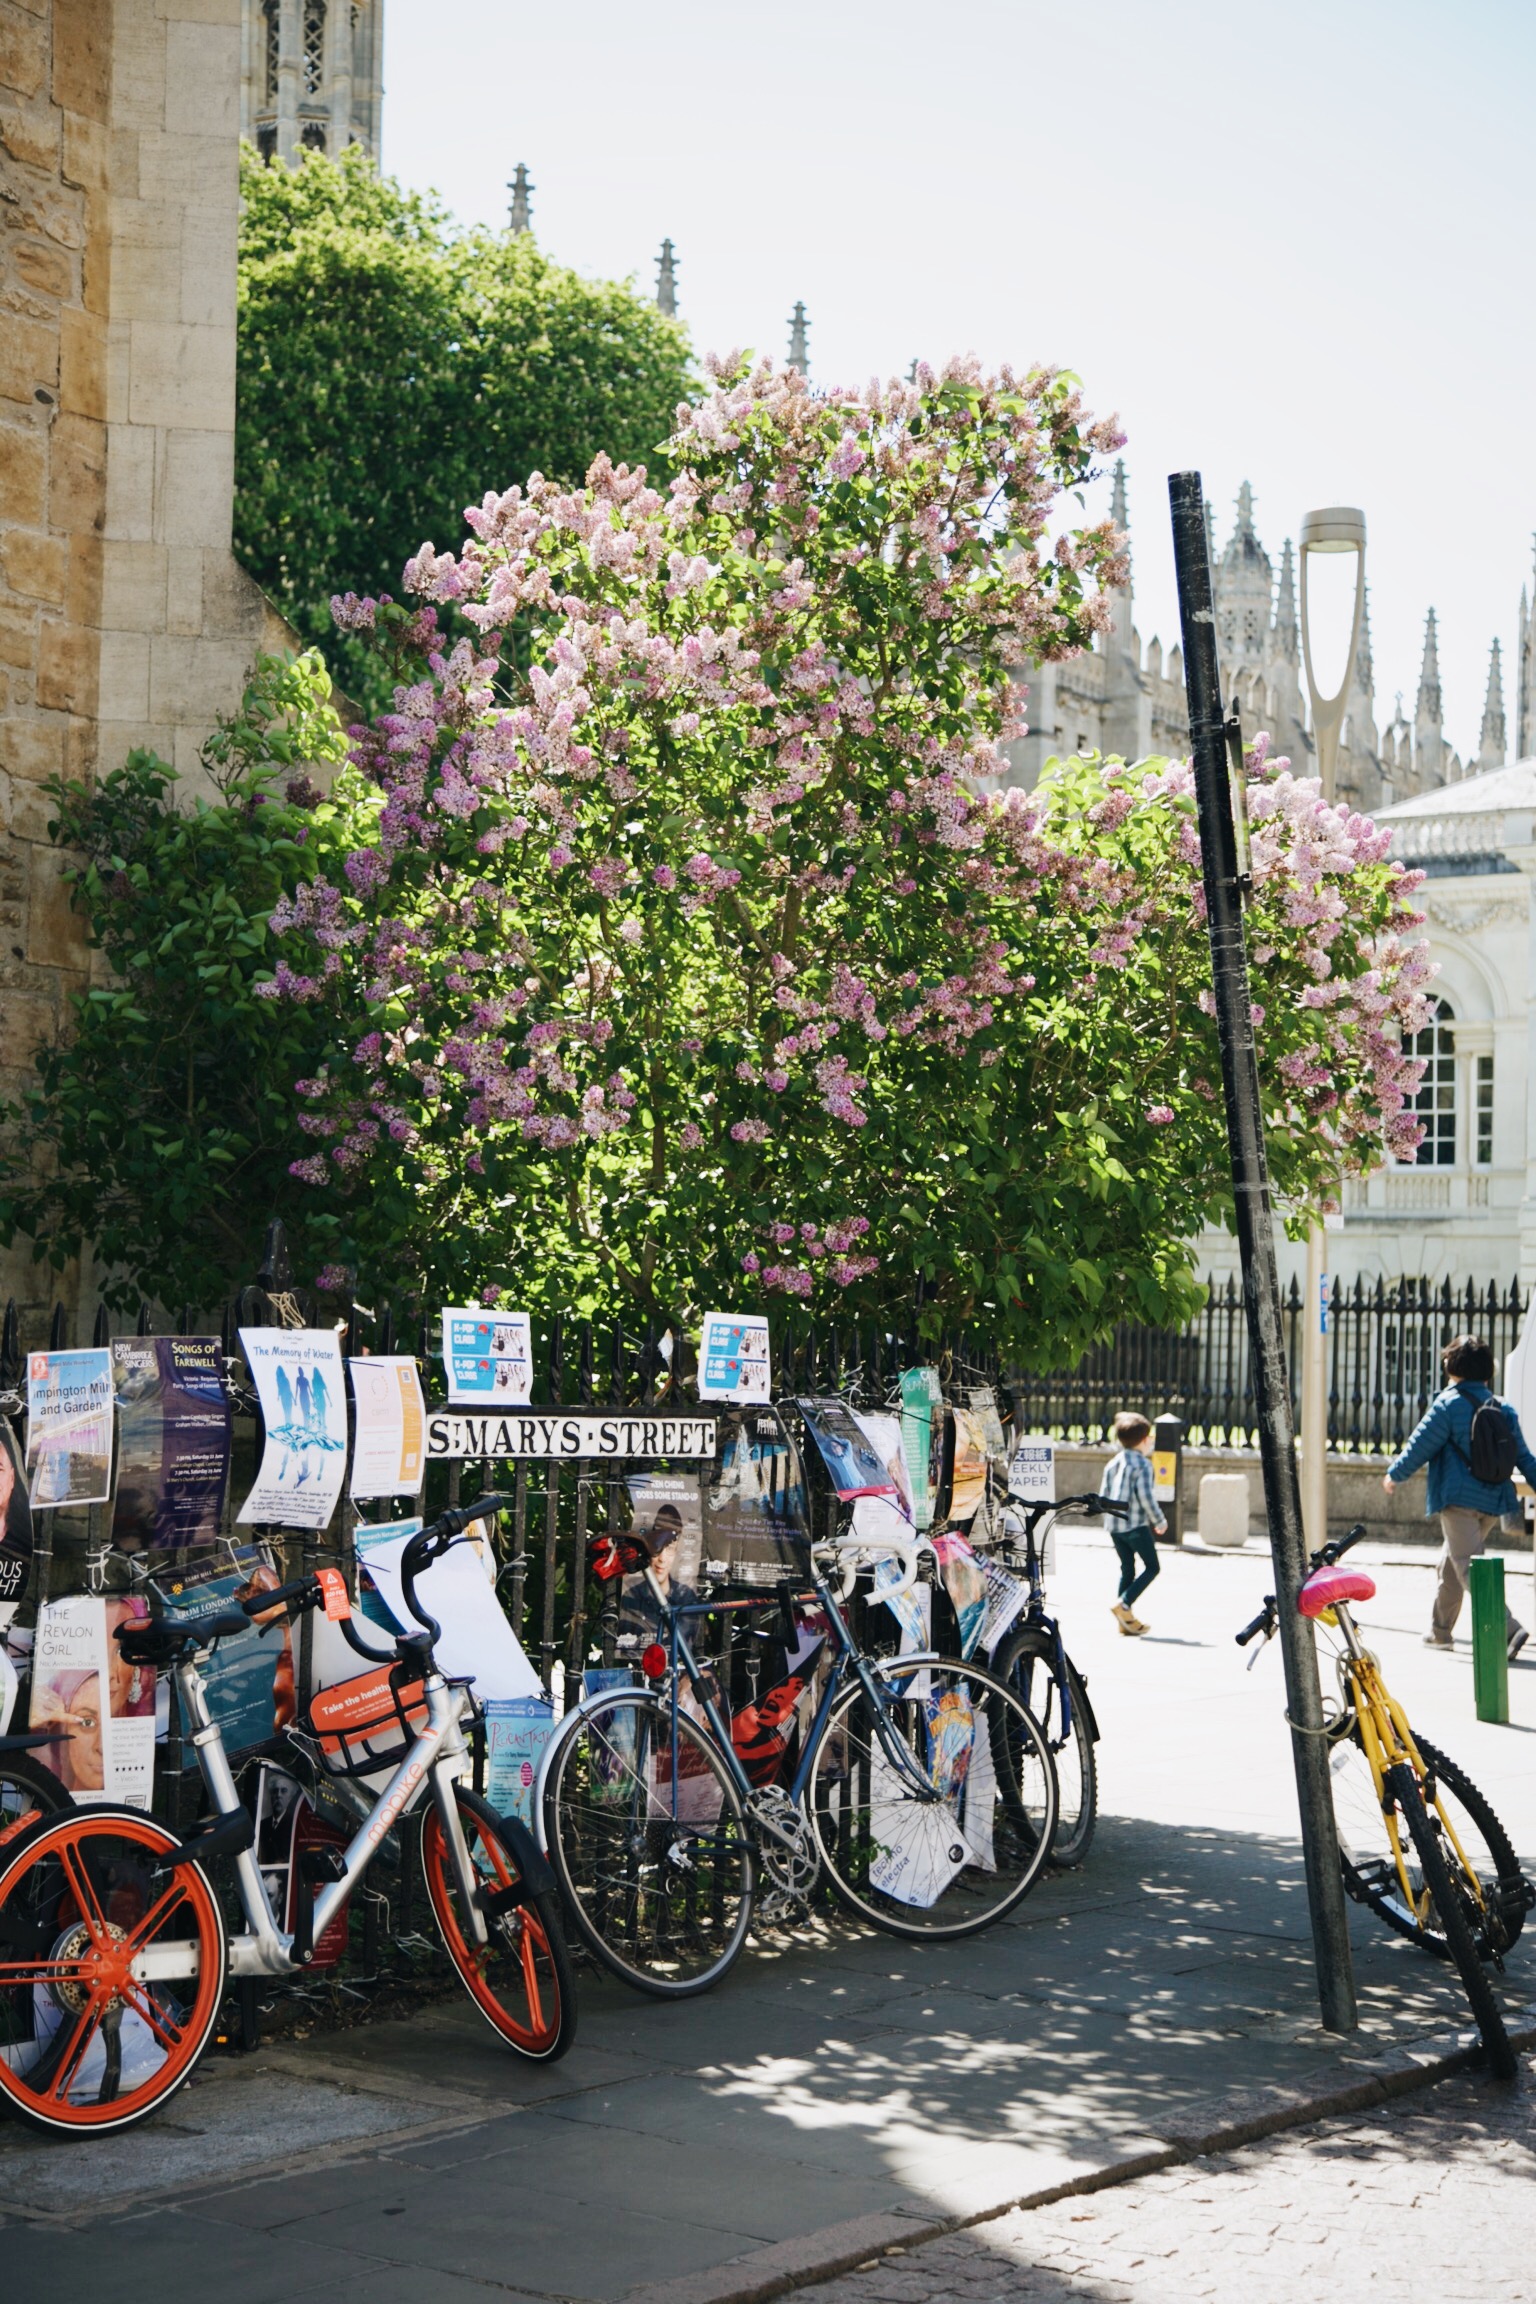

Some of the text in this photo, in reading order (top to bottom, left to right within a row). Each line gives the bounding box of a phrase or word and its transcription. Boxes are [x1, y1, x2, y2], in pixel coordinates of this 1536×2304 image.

[454, 1323, 475, 1333] K-POP
[454, 1334, 476, 1344] CLASS
[114, 1343, 132, 1352] NEW
[171, 1342, 216, 1354] SONGS OF
[253, 1346, 334, 1360] The Memory of Water
[115, 1351, 154, 1360] CAMBRIDGE
[174, 1355, 217, 1367] FAREWELL
[125, 1360, 156, 1369] SINGERS
[40, 1401, 102, 1415] and Garden
[465, 1419, 580, 1456] MARYS
[599, 1421, 712, 1456] STREET
[1013, 1464, 1052, 1473] EEKLY
[651, 1480, 685, 1490] KEN CHENG
[636, 1491, 699, 1501] DOES SOME STAND-UP
[200, 1594, 235, 1611] LONDON
[45, 1607, 70, 1620] THE
[43, 1623, 93, 1638] REVLON
[42, 1641, 72, 1656] GIRL
[321, 1684, 391, 1716] Take the healthy
[368, 1762, 423, 1844] mobike
[881, 1856, 910, 1888] electra
